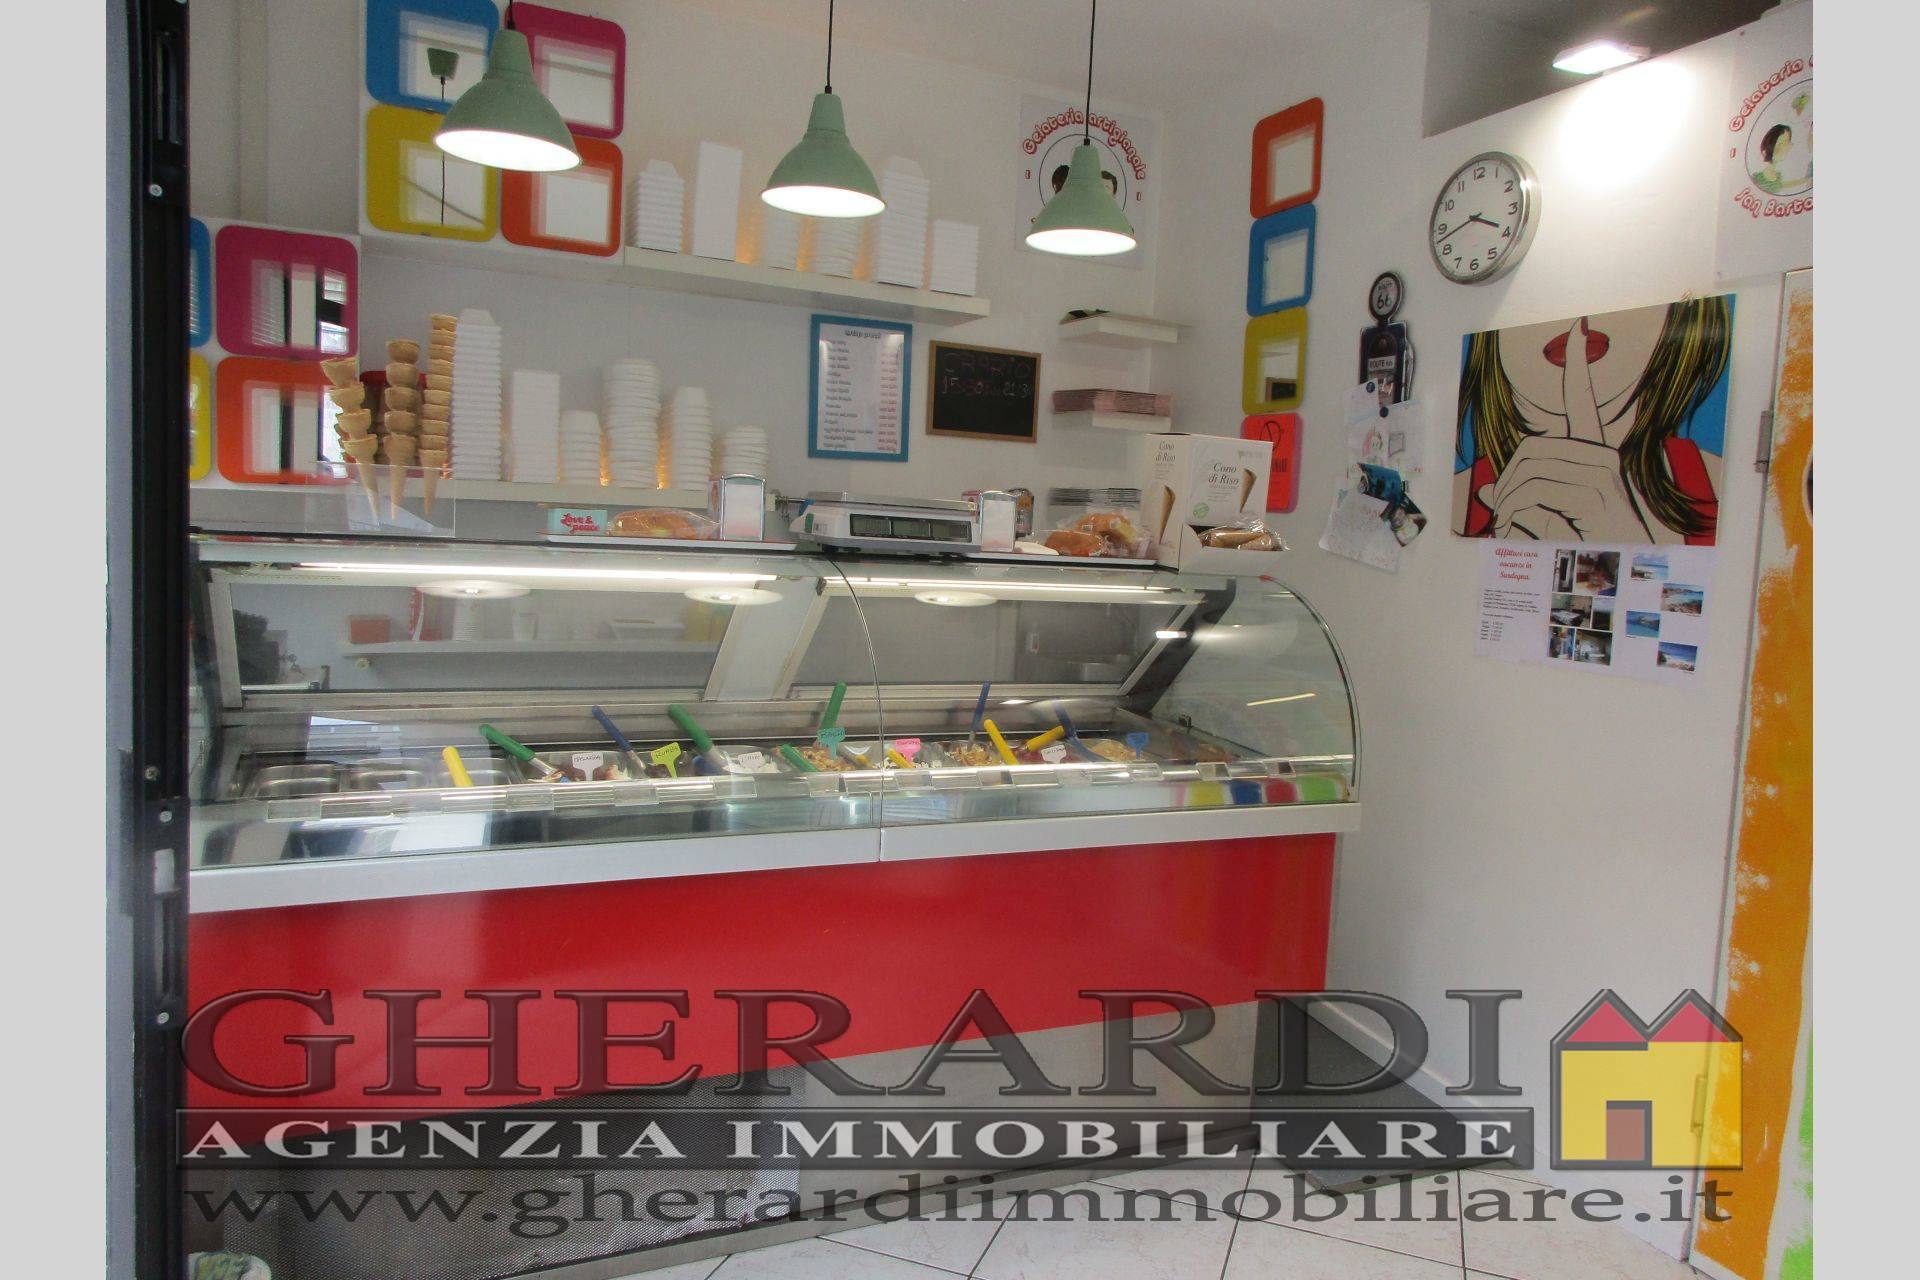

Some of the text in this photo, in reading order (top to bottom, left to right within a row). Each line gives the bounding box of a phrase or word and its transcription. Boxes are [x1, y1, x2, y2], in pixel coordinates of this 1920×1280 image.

[1729, 58, 1804, 132] Gelateria
[1022, 108, 1148, 181] Gelateria artigianale
[1473, 166, 1486, 180] 12
[1457, 180, 1465, 192] 11
[1503, 180, 1514, 193] 2
[1444, 199, 1455, 212] 10
[1508, 202, 1518, 215] 3
[1438, 223, 1448, 235] 9
[1501, 226, 1511, 238] 4
[1442, 244, 1452, 255] 8
[1487, 247, 1498, 259] 5
[1454, 257, 1462, 269] 7
[1469, 258, 1479, 270] 6
[1376, 294, 1393, 309] 66
[1369, 359, 1385, 368] ROUTE
[1213, 463, 1237, 473] Cono
[1208, 474, 1239, 485] di Riso
